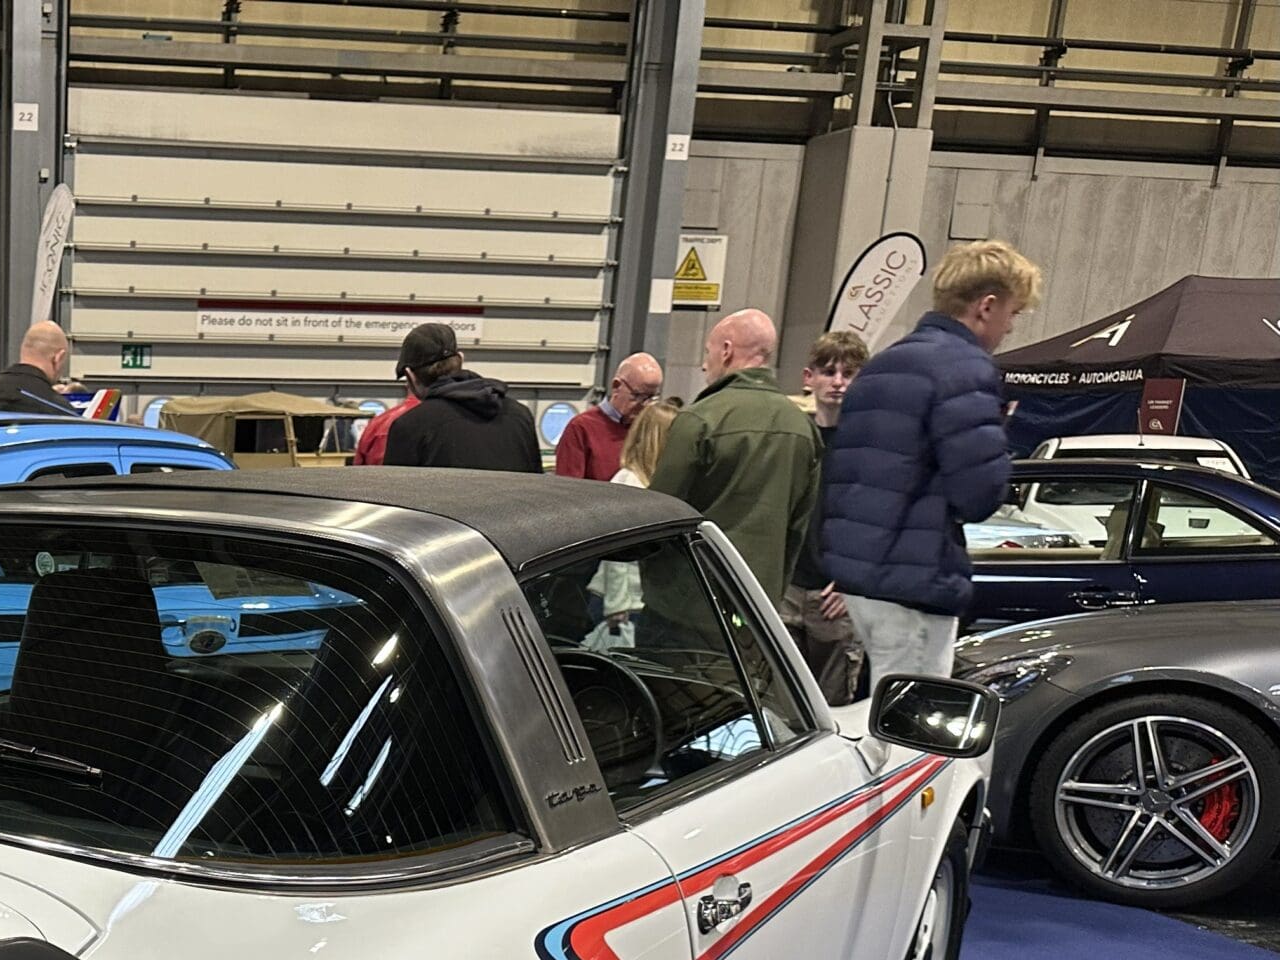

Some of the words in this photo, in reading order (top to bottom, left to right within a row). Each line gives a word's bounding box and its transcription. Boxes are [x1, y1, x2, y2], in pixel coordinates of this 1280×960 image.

[200, 315, 235, 327] Please
[237, 316, 252, 327] do
[255, 316, 273, 328] not
[276, 317, 289, 328] sit
[291, 318, 301, 328] in
[303, 317, 329, 329] front
[332, 317, 344, 329] of
[345, 318, 362, 329] the
[364, 320, 419, 334] emergenc
[1004, 371, 1070, 385] MOTORCYCLES
[1078, 368, 1144, 384] AUTOMOBILIA
